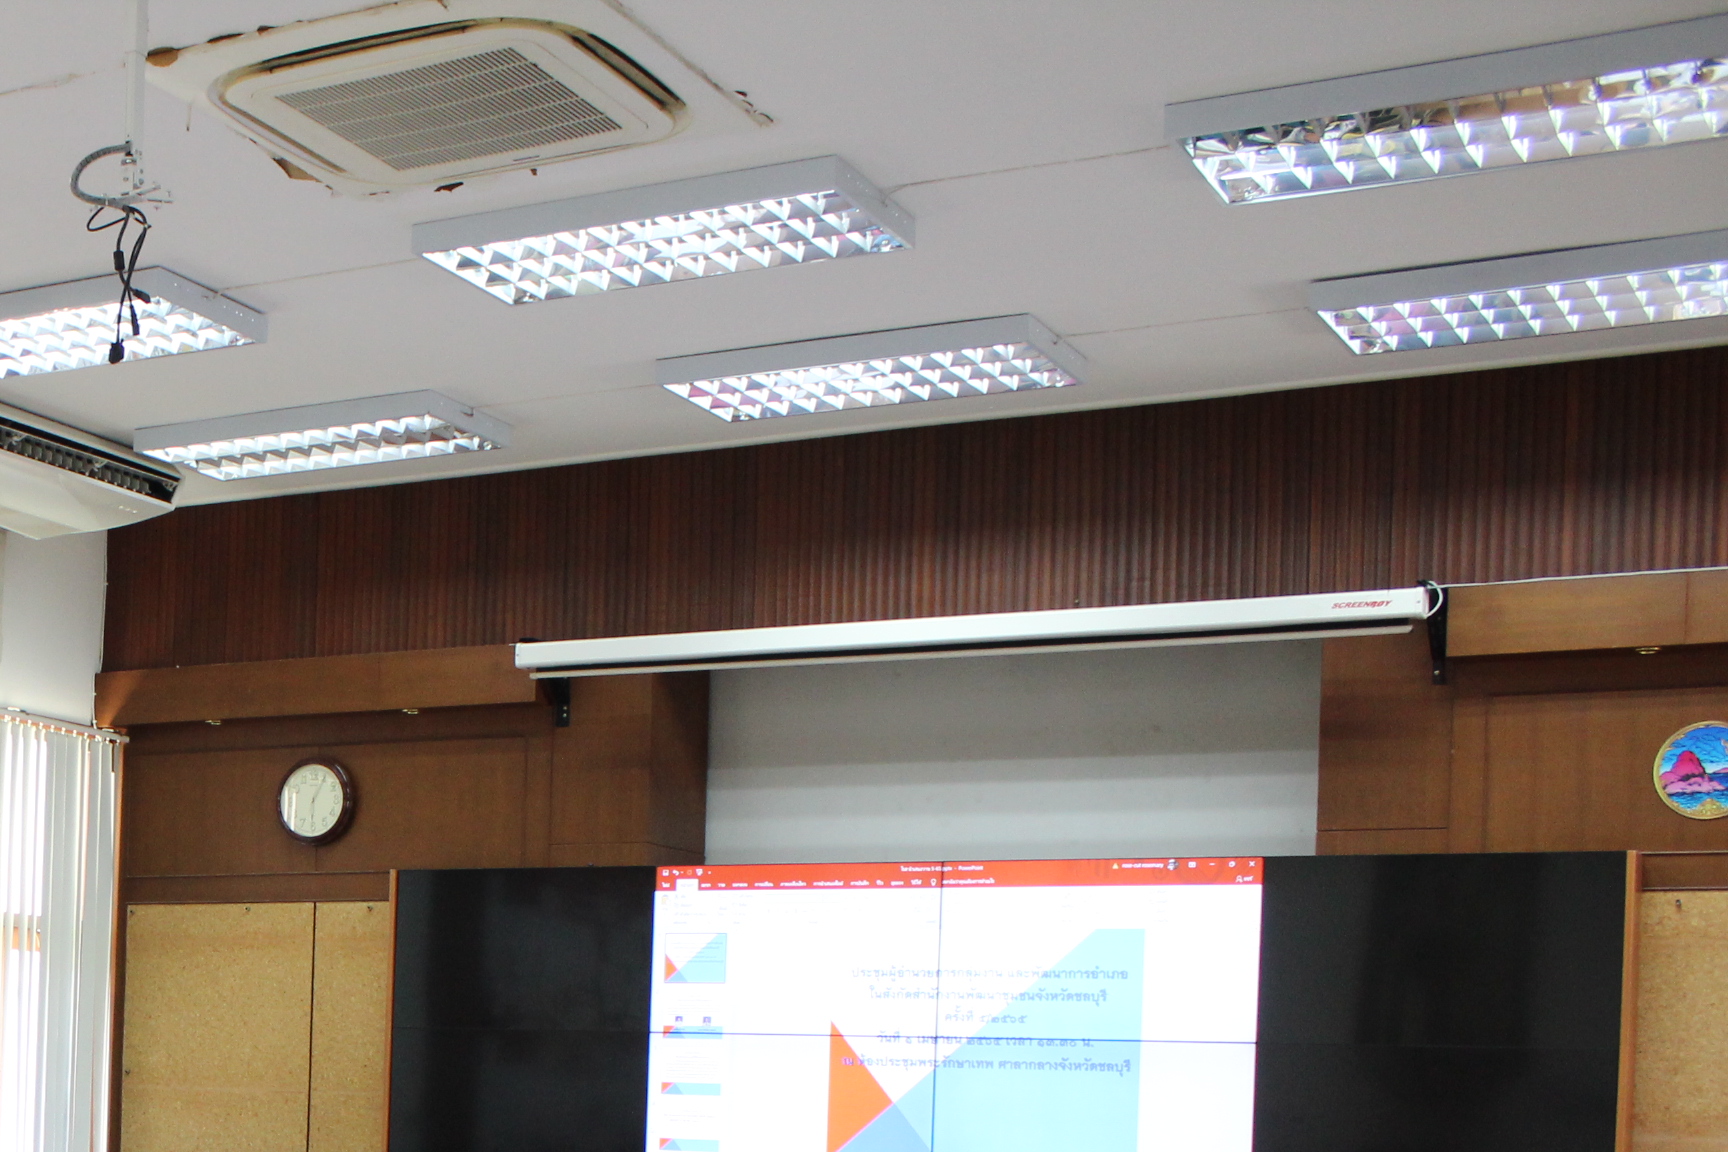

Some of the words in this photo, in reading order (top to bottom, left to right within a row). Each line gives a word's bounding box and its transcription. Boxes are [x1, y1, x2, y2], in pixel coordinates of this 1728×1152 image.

[998, 1056, 1131, 1077] ศาลากลางจังหวัดชลบุรี
